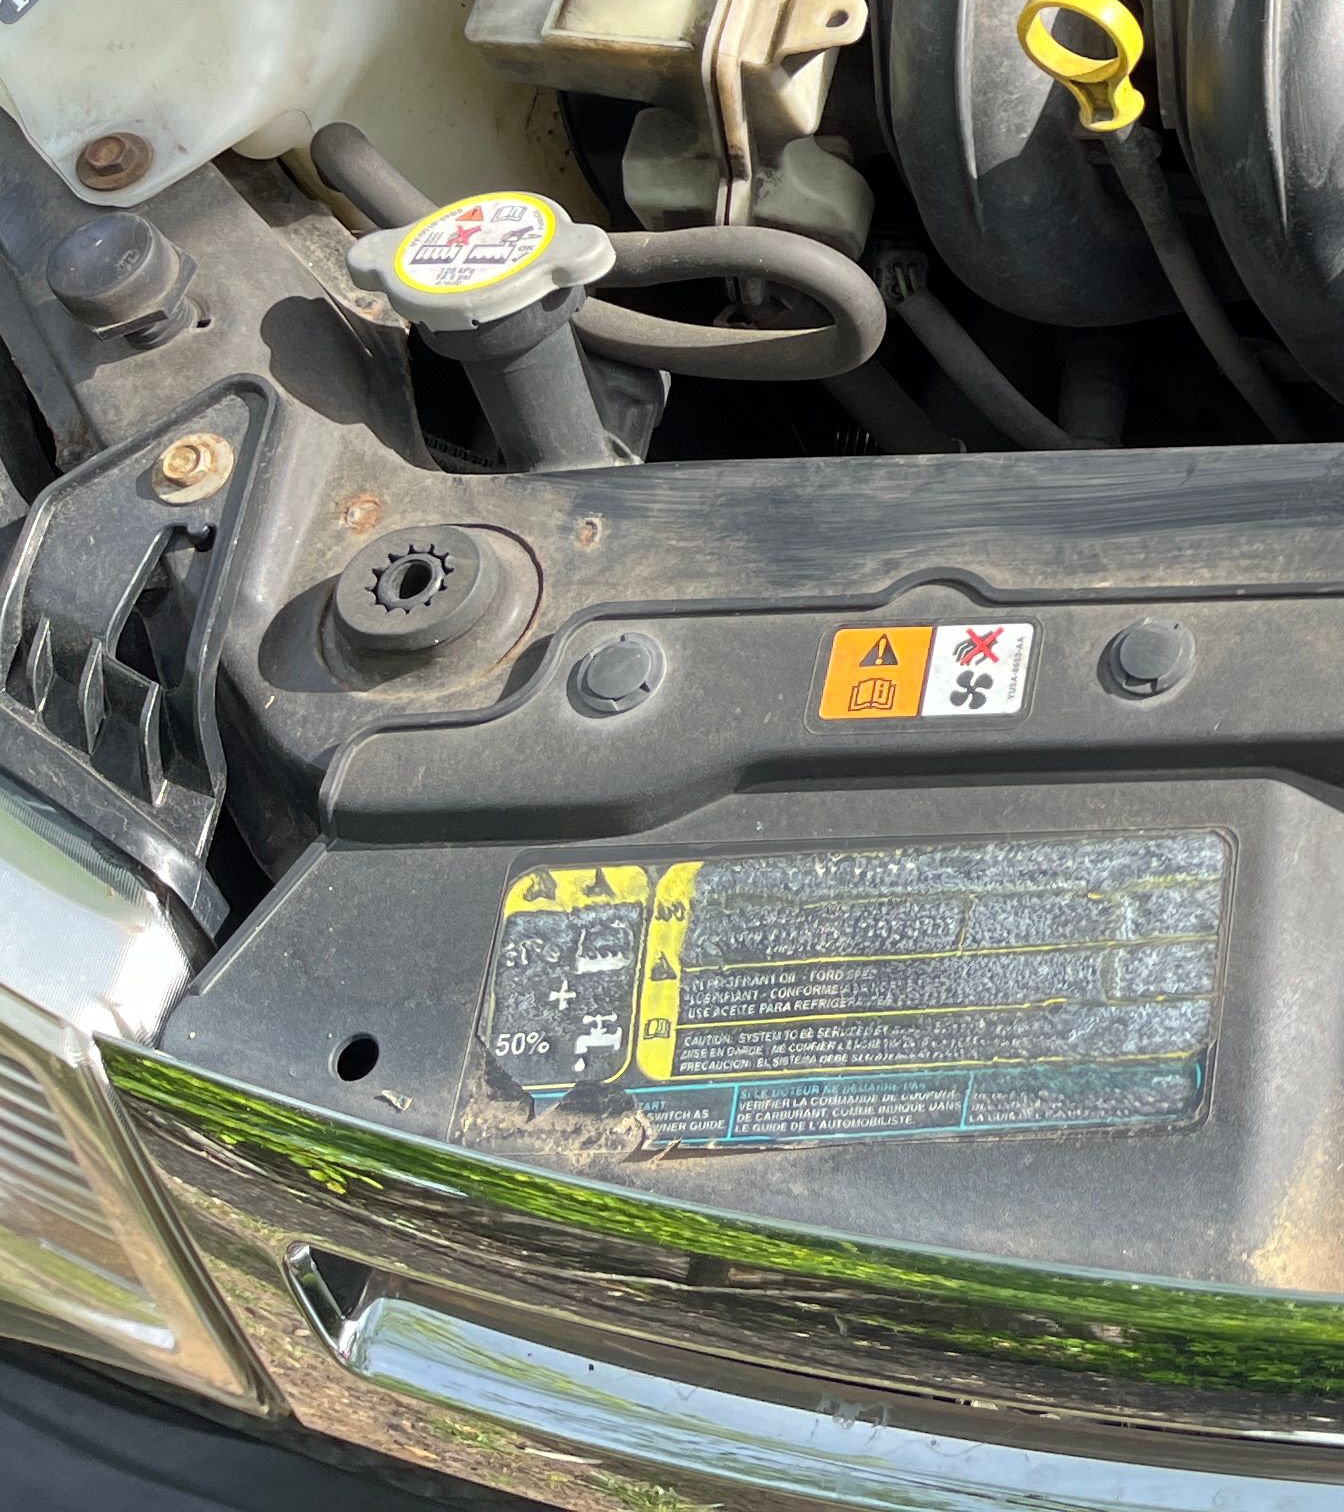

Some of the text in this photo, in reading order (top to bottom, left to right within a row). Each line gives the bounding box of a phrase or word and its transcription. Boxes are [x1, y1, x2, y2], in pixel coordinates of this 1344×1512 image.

[759, 1002, 791, 1015] PARA
[495, 1030, 550, 1057] 50%
[694, 1109, 709, 1120] AS
[737, 1112, 752, 1123] DE
[689, 1119, 725, 1130] GUIDE
[735, 1123, 749, 1133] LE
[752, 1121, 787, 1133] GUIDE
[790, 1120, 805, 1131] DE
